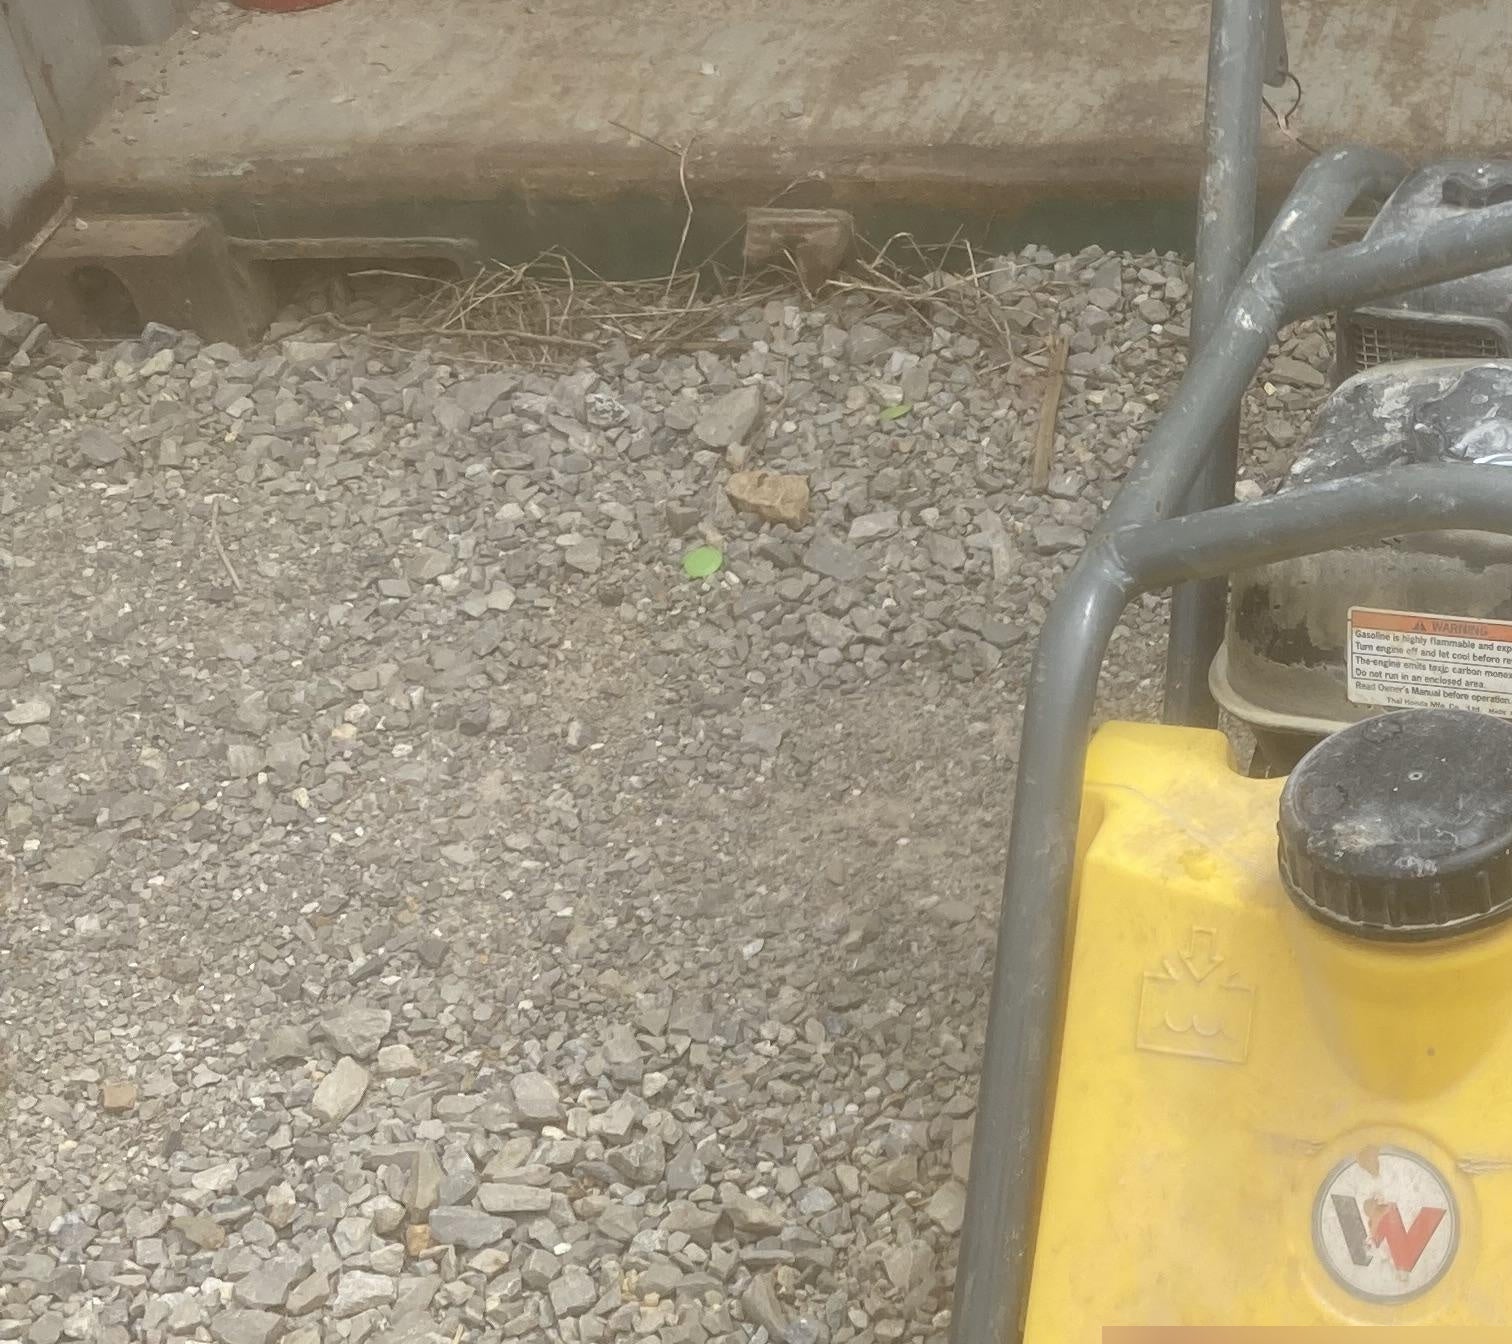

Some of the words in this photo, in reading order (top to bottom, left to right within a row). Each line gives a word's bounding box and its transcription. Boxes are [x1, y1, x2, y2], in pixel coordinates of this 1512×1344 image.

[1433, 622, 1488, 637] WARNING
[1355, 630, 1391, 640] Gasoline
[1393, 633, 1400, 641] is
[1402, 634, 1427, 645] highly
[1430, 636, 1476, 648] flammable
[1478, 643, 1494, 651] and
[1356, 642, 1374, 651] Turn
[1376, 645, 1403, 654] engine
[1406, 646, 1418, 655] off
[1421, 649, 1436, 658] and
[1439, 650, 1449, 659] let
[1452, 652, 1470, 661] cool
[1473, 653, 1500, 663] before
[1356, 656, 1371, 665] The
[1373, 659, 1401, 668] engine
[1404, 661, 1427, 671] emits
[1429, 663, 1449, 673] toxic
[1452, 666, 1482, 676] carbon
[1355, 668, 1366, 676] Do
[1369, 669, 1382, 678] not
[1401, 672, 1409, 681] in
[1411, 674, 1422, 682] an
[1425, 676, 1462, 686] enclosed
[1465, 680, 1486, 689] area.
[1356, 681, 1376, 690] Read
[1378, 683, 1409, 694] Owner's
[1411, 687, 1441, 697] Manual
[1443, 689, 1469, 700] before
[1471, 694, 1512, 704] operation.
[1387, 696, 1402, 704] Thai
